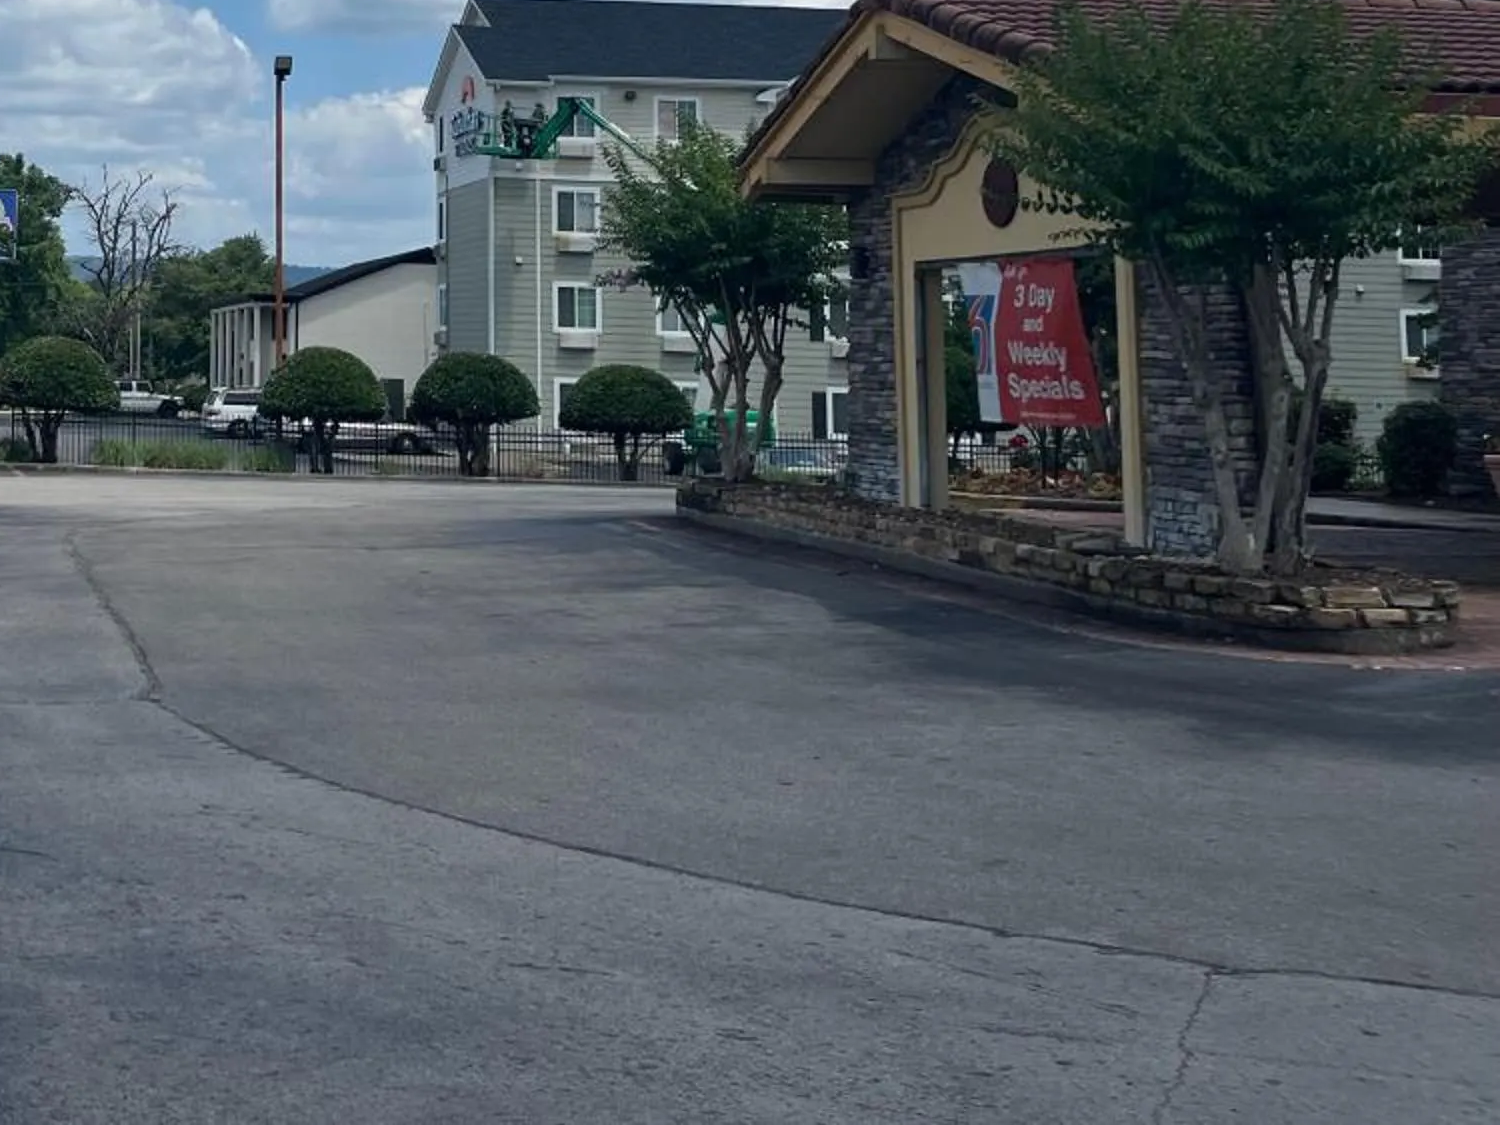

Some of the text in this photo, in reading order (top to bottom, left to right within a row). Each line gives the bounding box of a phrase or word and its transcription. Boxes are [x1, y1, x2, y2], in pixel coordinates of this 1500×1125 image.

[1014, 284, 1055, 313] 3 Day
[1023, 315, 1043, 332] and
[1008, 340, 1067, 372] Weekly
[1008, 373, 1085, 402] Specials
